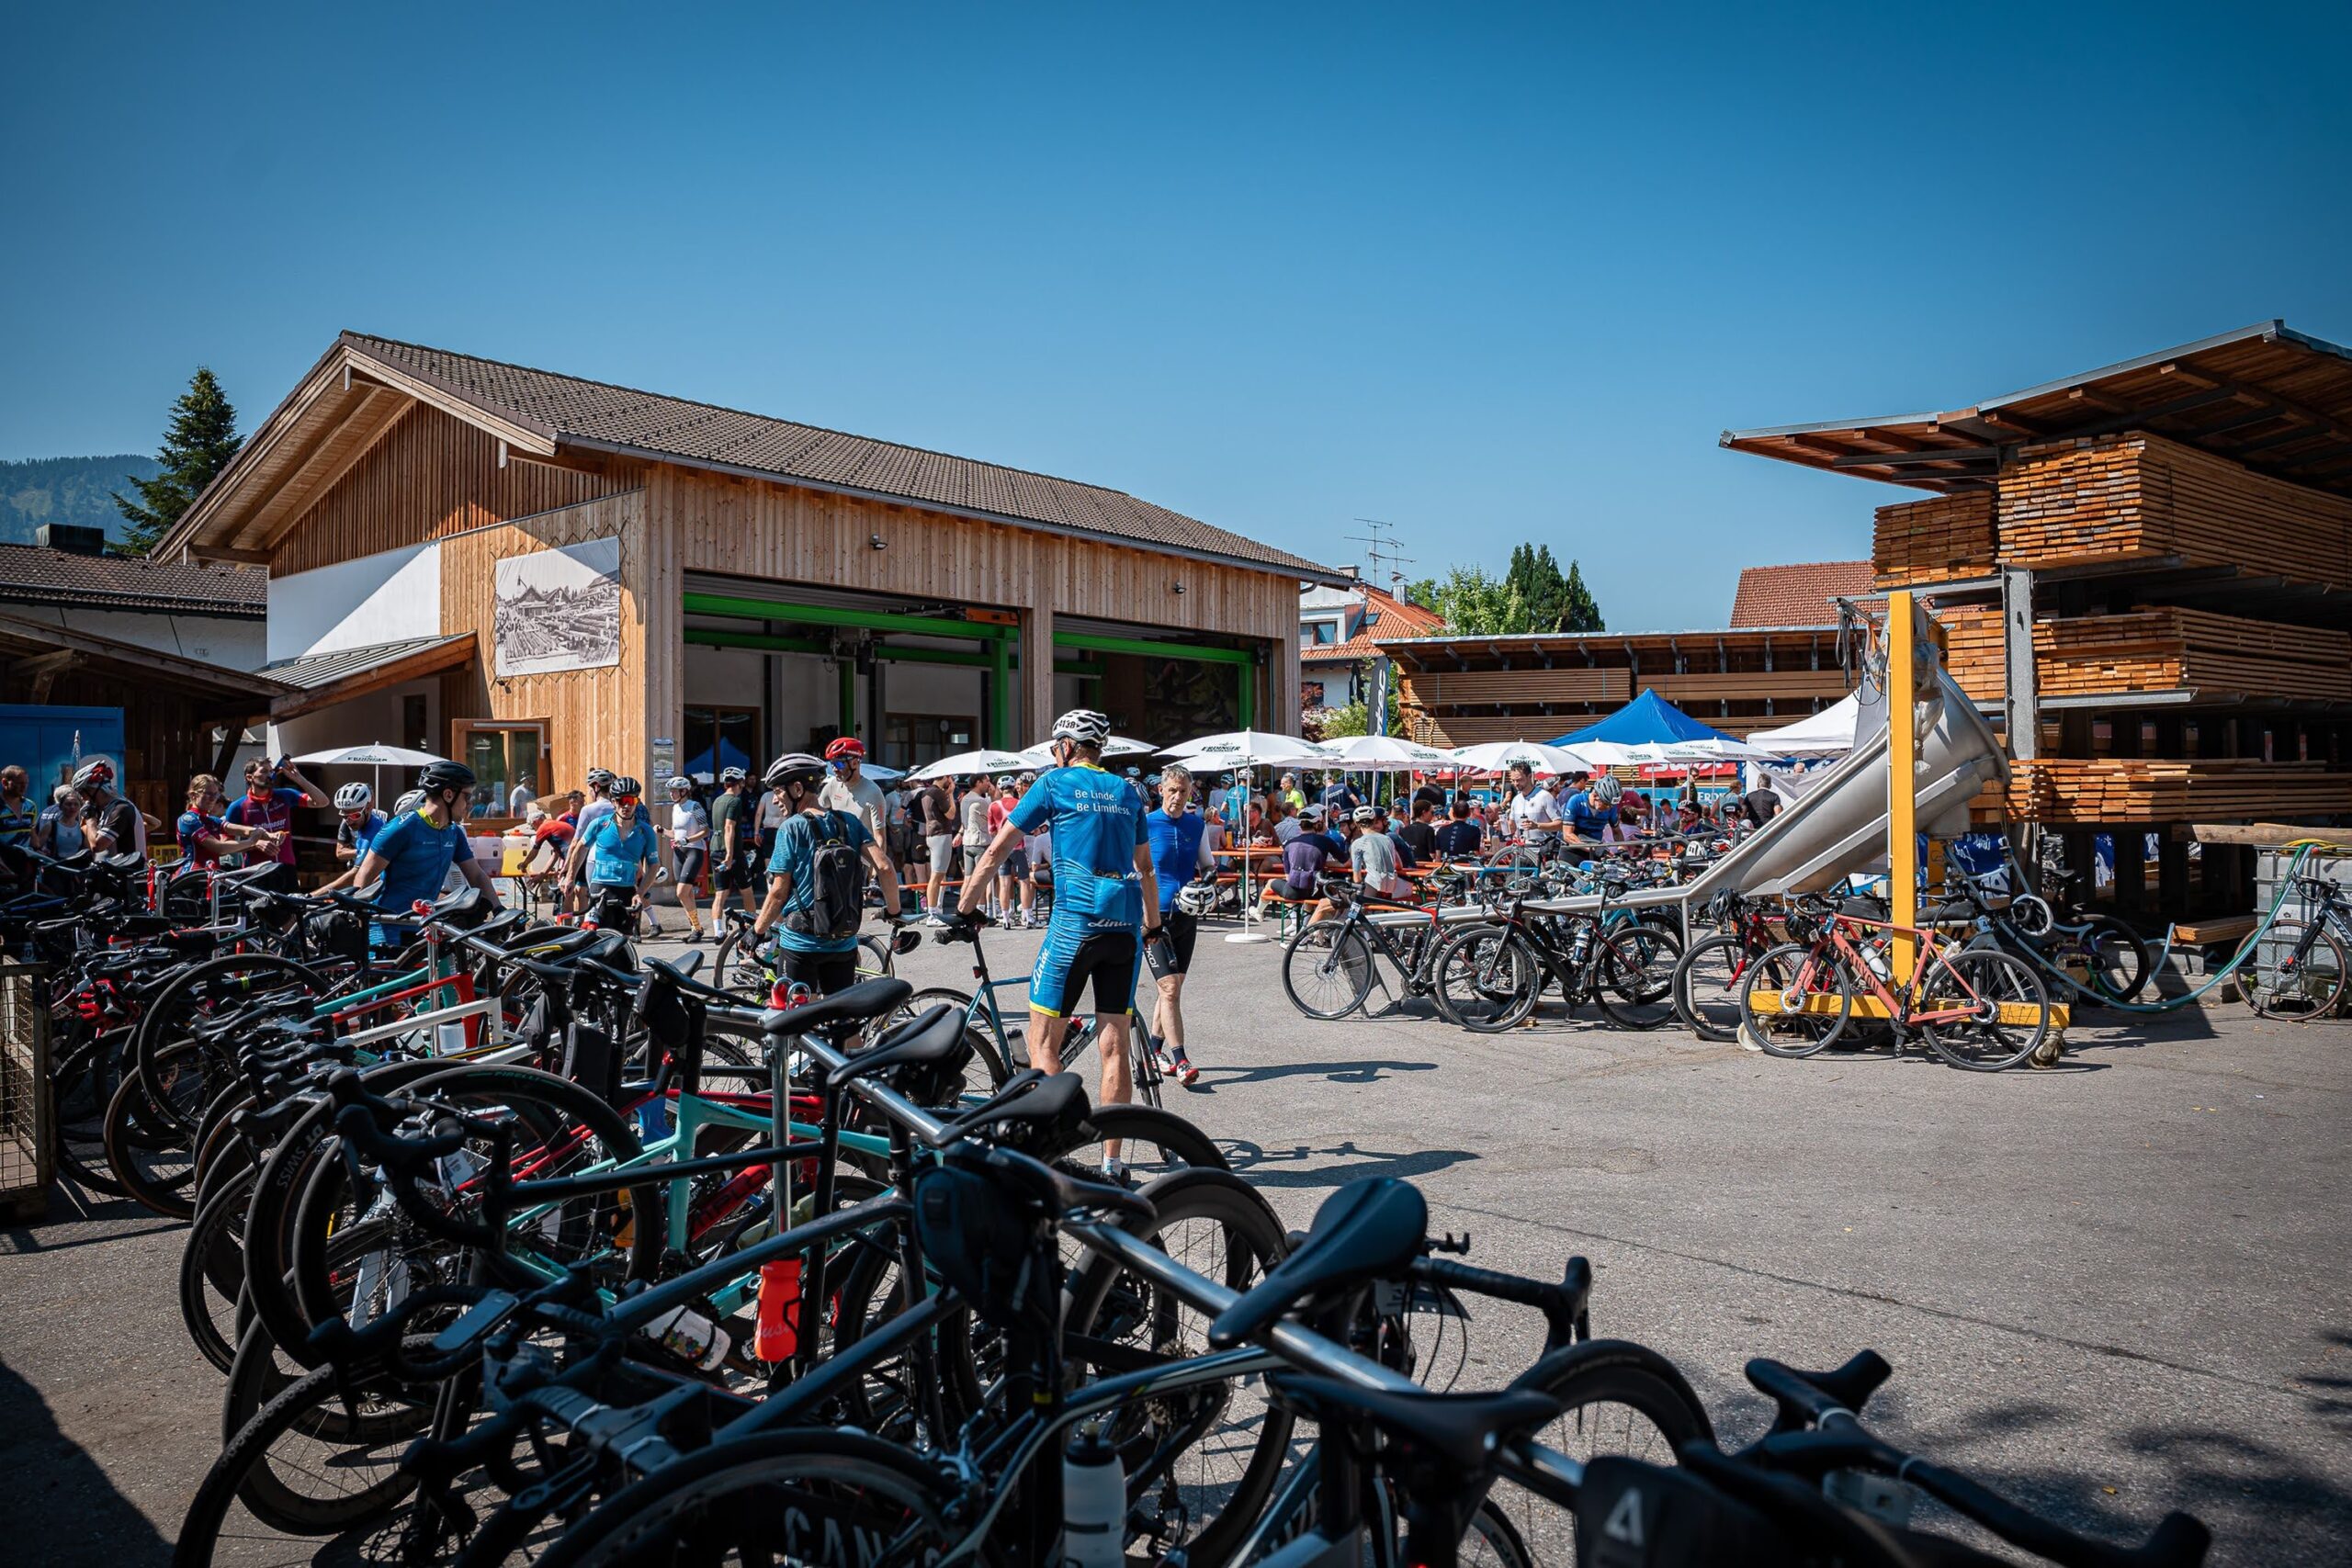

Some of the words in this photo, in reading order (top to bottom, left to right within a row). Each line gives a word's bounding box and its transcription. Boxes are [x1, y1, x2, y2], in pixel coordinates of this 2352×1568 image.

[1057, 719, 1076, 728] 4138
[1075, 789, 1088, 798] Be
[1091, 790, 1117, 801] Linde.
[1077, 803, 1090, 812] Be
[1093, 803, 1131, 815] Limitless.
[1844, 946, 1879, 993] CANYON
[494, 1071, 540, 1081] PIRELLI
[306, 1123, 325, 1148] DT
[277, 1145, 306, 1189] SWISS
